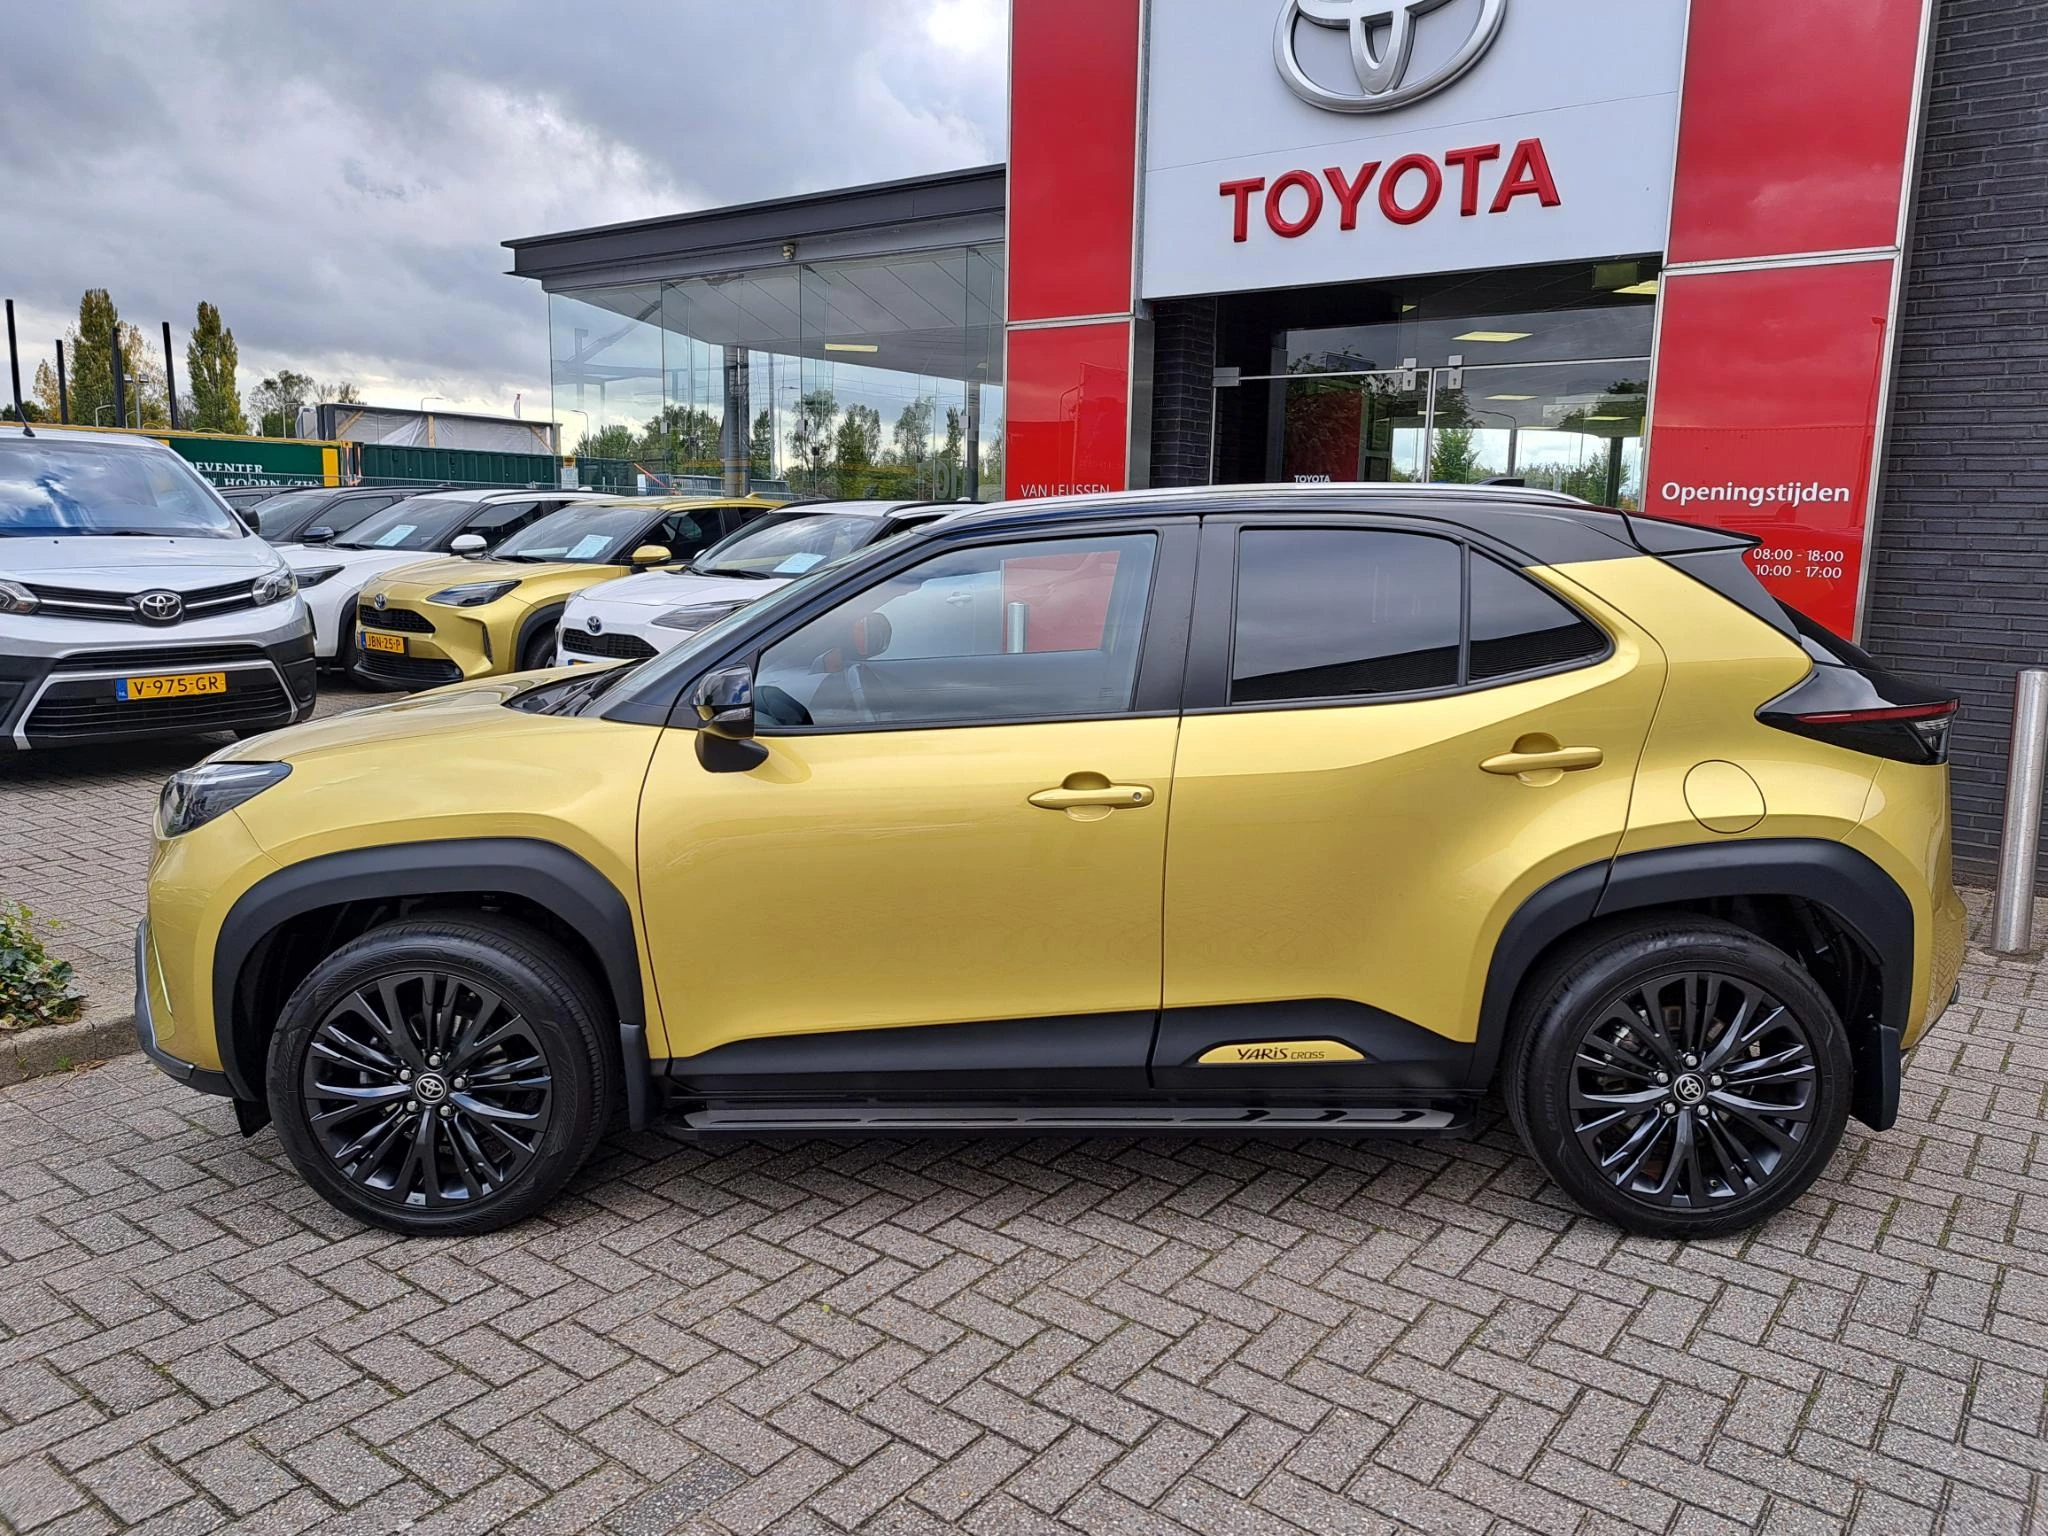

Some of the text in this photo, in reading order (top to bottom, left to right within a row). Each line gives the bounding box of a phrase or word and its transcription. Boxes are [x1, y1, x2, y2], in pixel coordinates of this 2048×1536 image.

[1219, 138, 1561, 242] TOYOTA
[1294, 474, 1331, 483] TOYOTA
[1021, 484, 1048, 498] VAN
[1661, 481, 1850, 507] Openingstijden
[1753, 548, 1793, 561] 08:00
[1807, 549, 1844, 563] 18:00
[1755, 564, 1792, 577] 10:00
[1805, 566, 1842, 579] 17:00
[133, 676, 219, 696] V-975-GR
[1291, 1051, 1326, 1060] CROSS
